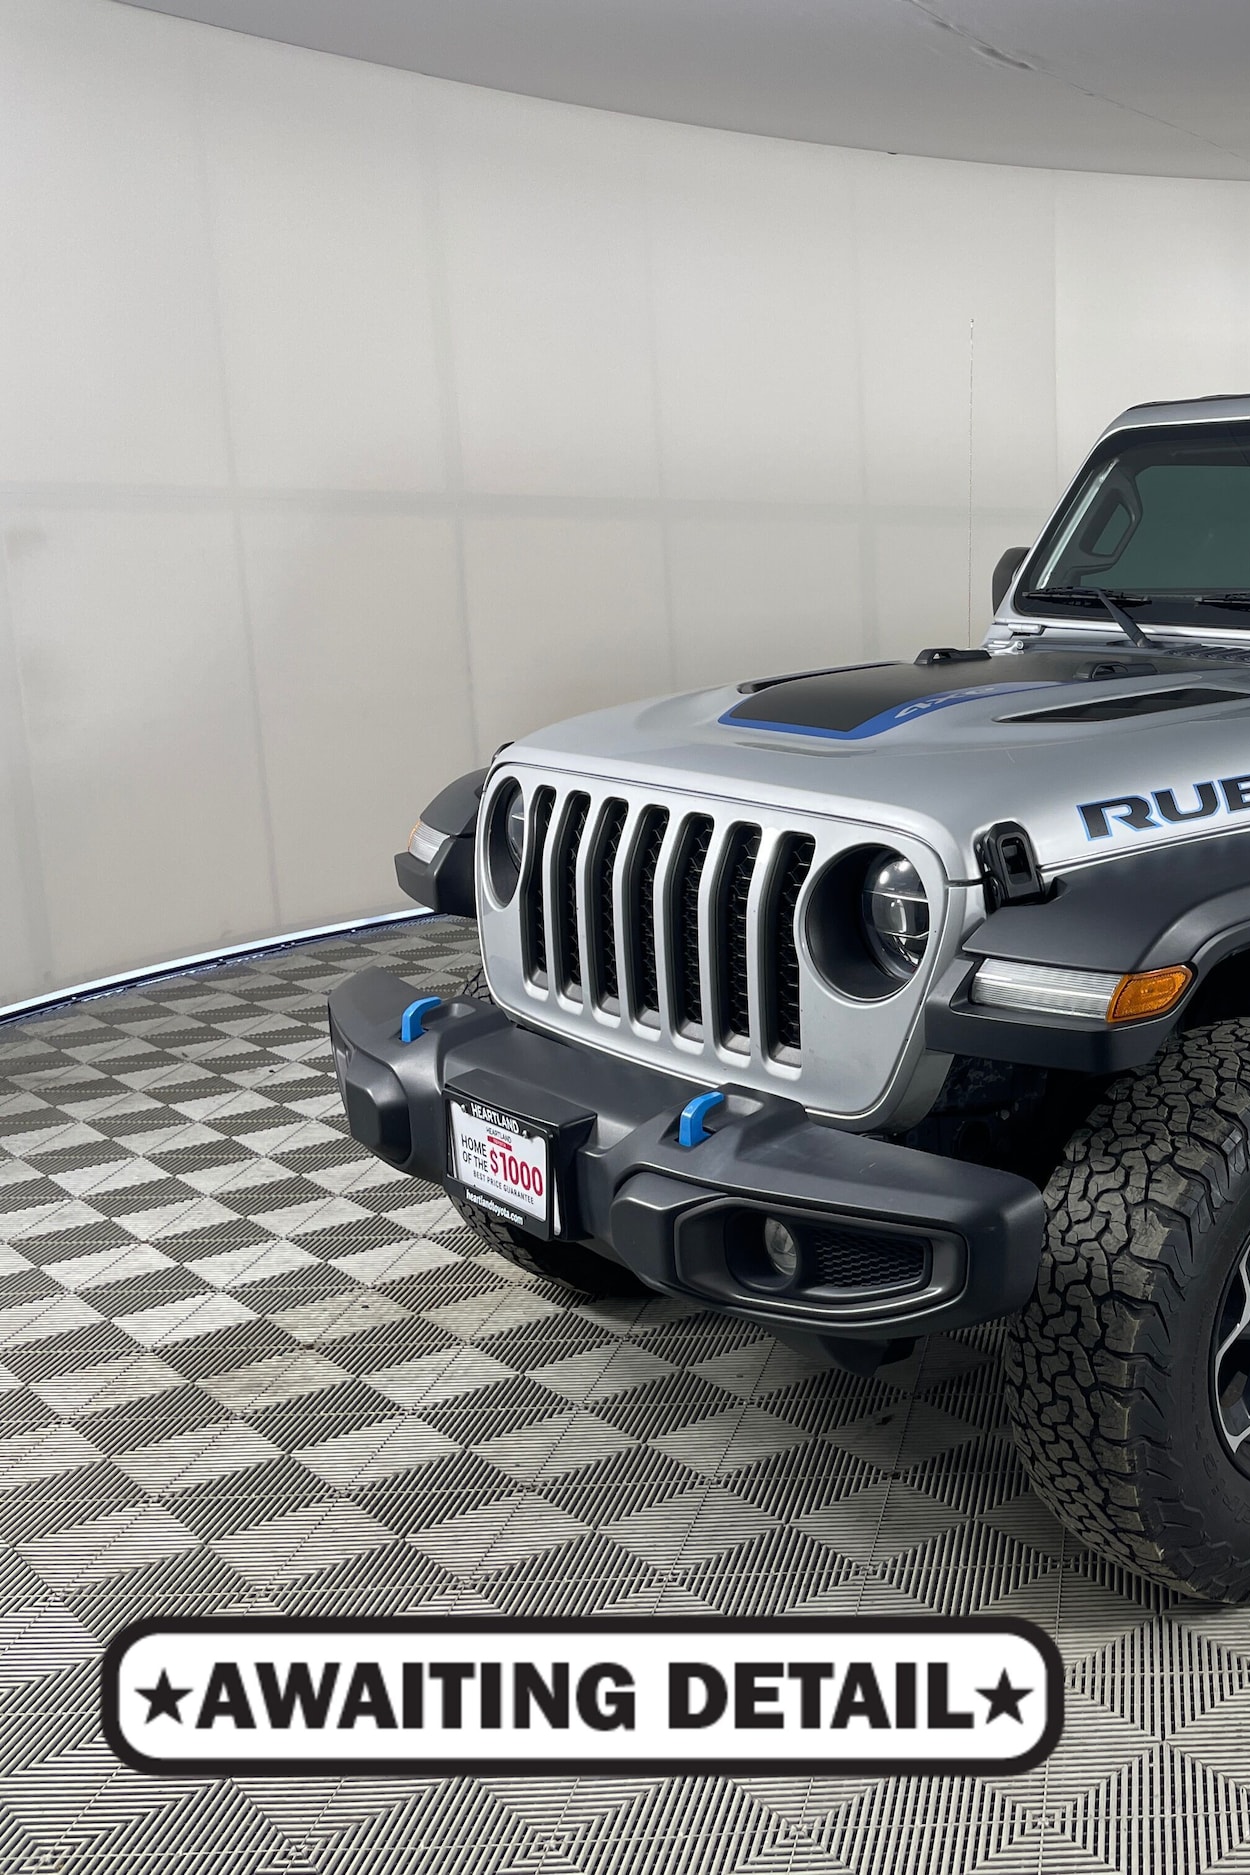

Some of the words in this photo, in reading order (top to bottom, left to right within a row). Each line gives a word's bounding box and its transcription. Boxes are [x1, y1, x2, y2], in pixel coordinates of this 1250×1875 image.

[470, 1102, 520, 1134] HEARTLAND
[461, 1134, 487, 1157] HOME
[486, 1126, 512, 1143] HEARTLAND
[462, 1151, 472, 1164] OF
[474, 1154, 489, 1173] THE
[489, 1147, 544, 1197] $1000
[473, 1169, 486, 1183] BEST
[487, 1174, 502, 1190] PRICE
[503, 1182, 534, 1205] GUARANTEE
[466, 1189, 524, 1226] heartlandtoyota.com
